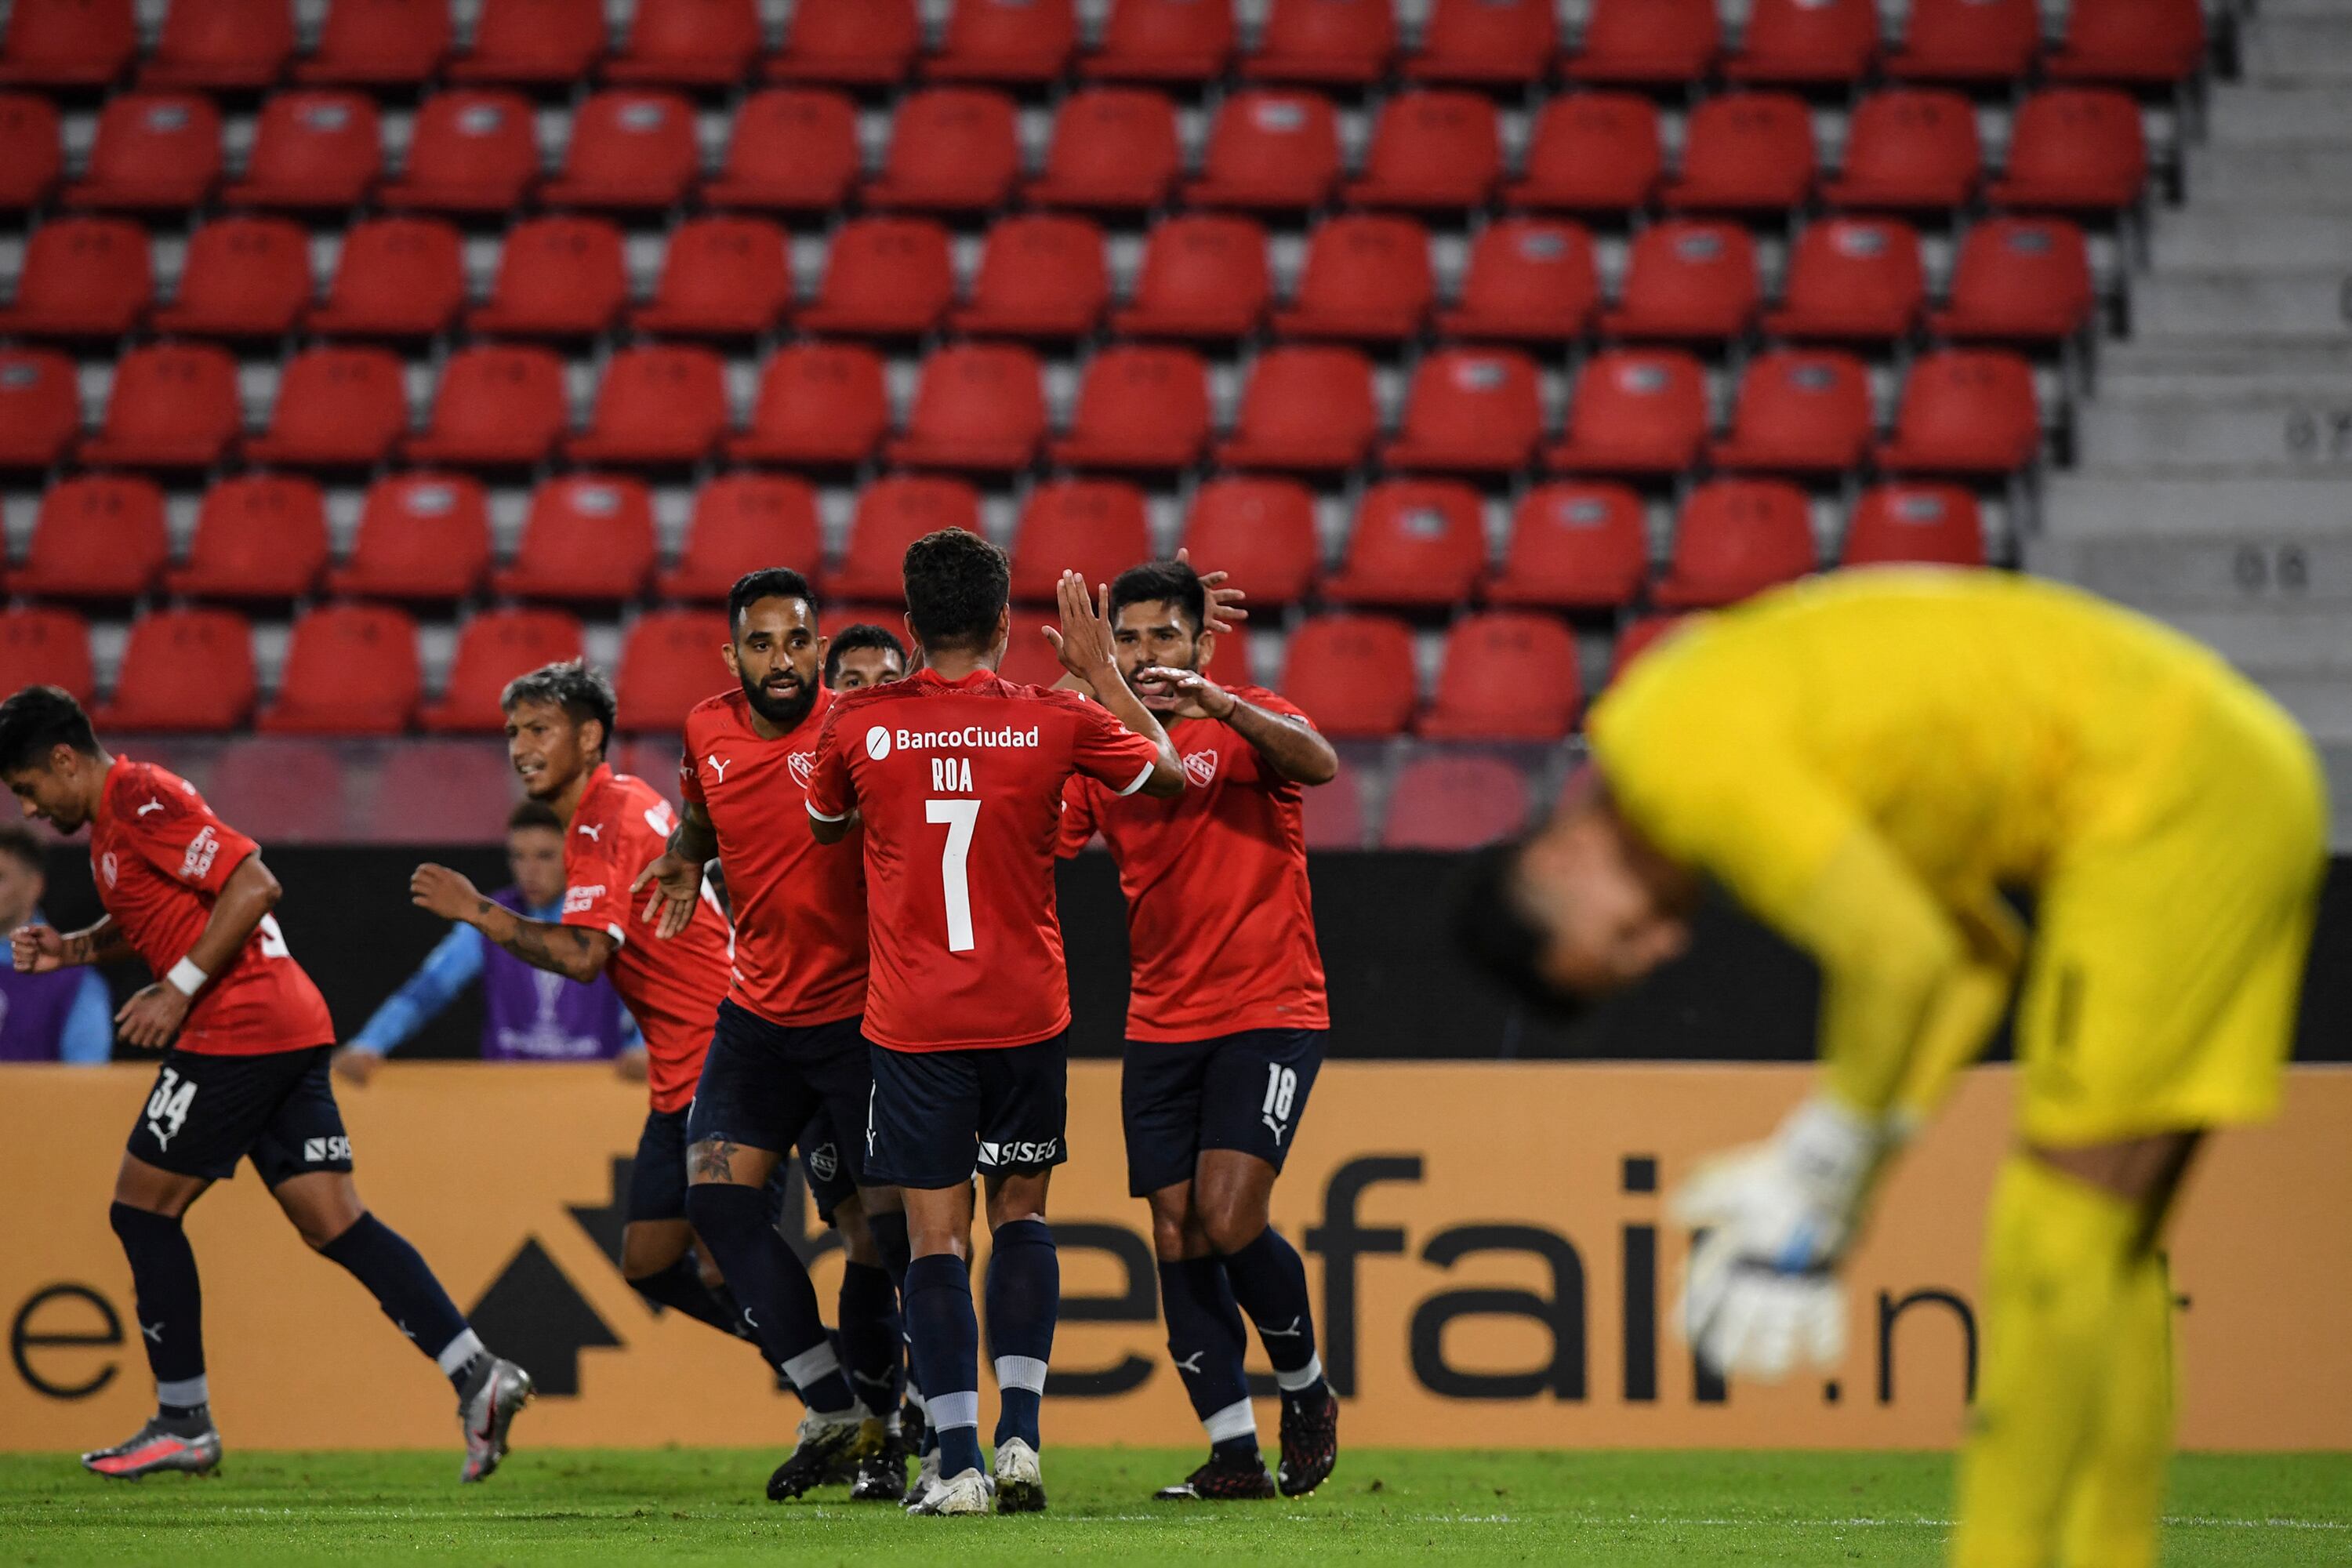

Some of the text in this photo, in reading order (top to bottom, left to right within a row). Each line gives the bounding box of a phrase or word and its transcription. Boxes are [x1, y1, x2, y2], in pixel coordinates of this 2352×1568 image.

[896, 725, 1039, 750] BancoCiudad
[931, 757, 973, 792] ROA
[925, 799, 982, 952] 7
[147, 1066, 198, 1133] 34
[1261, 1062, 1298, 1121] 18
